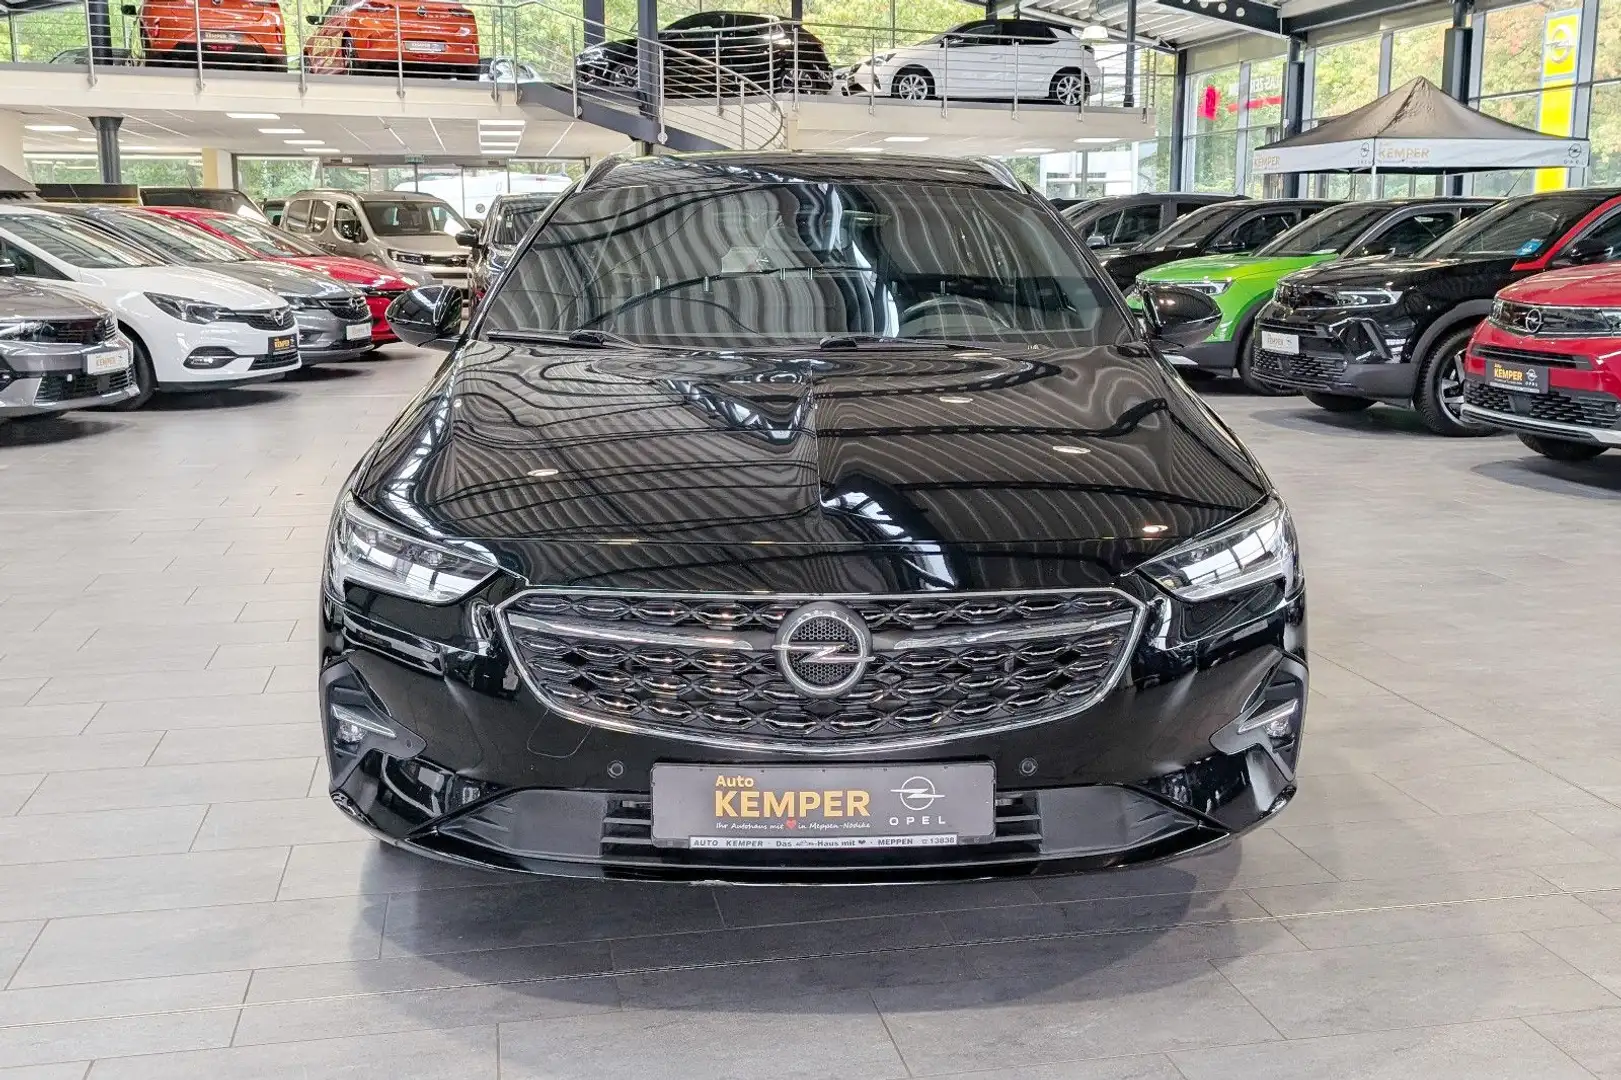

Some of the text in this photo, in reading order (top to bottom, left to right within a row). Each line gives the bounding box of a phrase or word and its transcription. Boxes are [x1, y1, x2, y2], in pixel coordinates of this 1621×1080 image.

[1378, 147, 1430, 159] KEMPER
[1253, 155, 1281, 167] KEMPER
[1494, 367, 1523, 381] KEMPER
[715, 775, 754, 787] Auto
[715, 790, 871, 817] KEMPER
[889, 816, 946, 826] OPEL
[726, 839, 764, 847] KEMPER
[878, 838, 913, 846] MEPPEN
[930, 836, 955, 844] 13838
